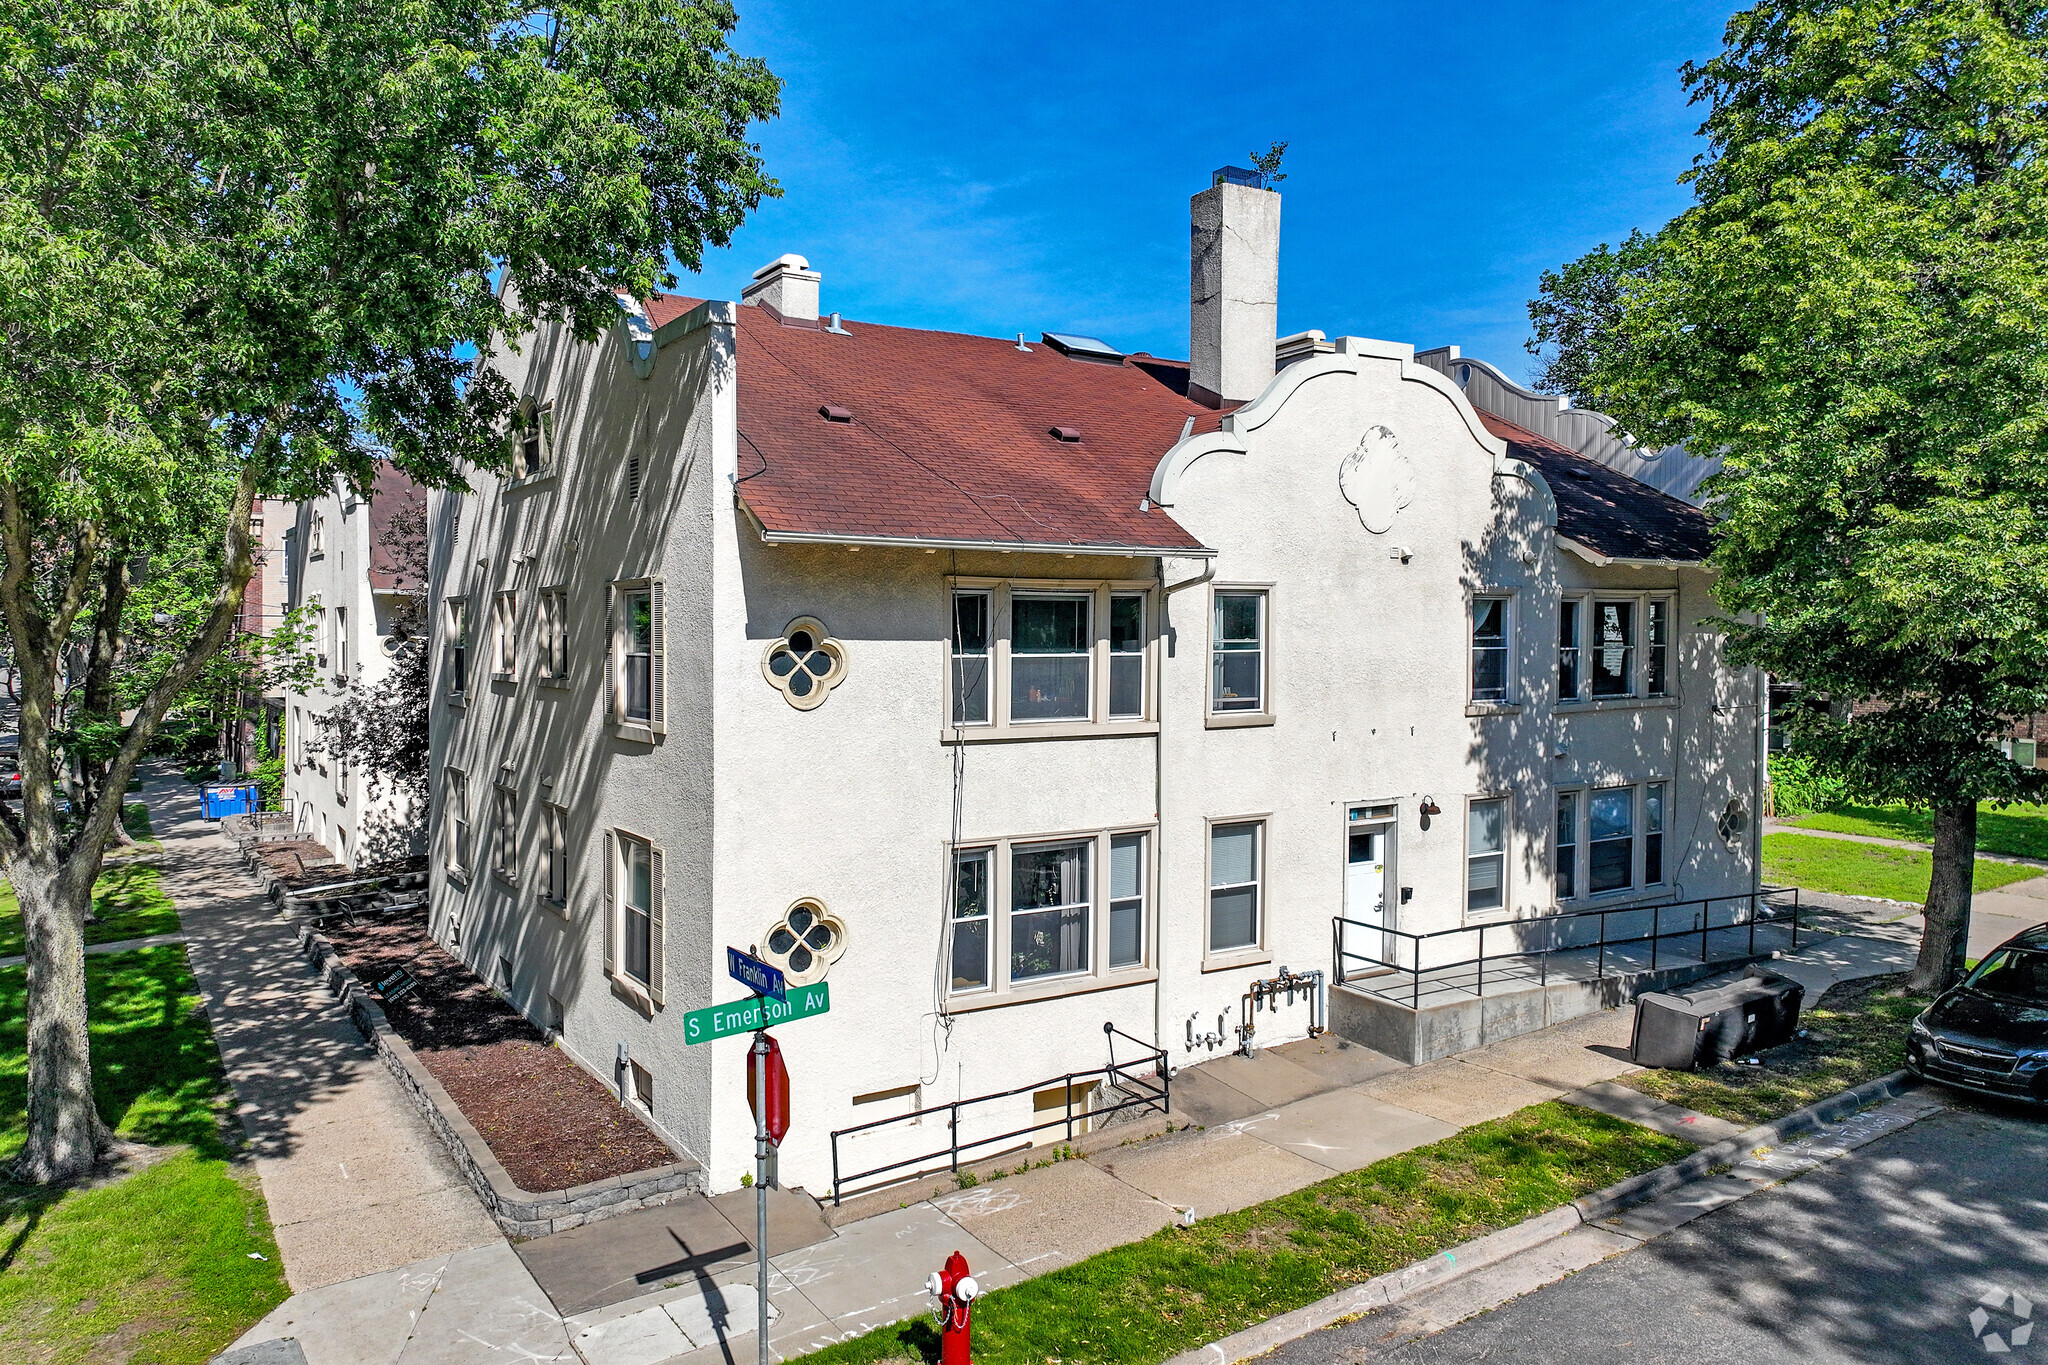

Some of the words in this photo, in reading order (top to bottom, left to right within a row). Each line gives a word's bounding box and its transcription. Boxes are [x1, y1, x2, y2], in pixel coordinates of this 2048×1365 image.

[381, 973, 398, 987] level
[728, 952, 735, 972] W
[738, 957, 768, 989] Franklin
[773, 974, 784, 995] Av
[689, 1018, 700, 1037] S
[713, 1001, 792, 1033] Emerson
[804, 992, 825, 1012] Av
